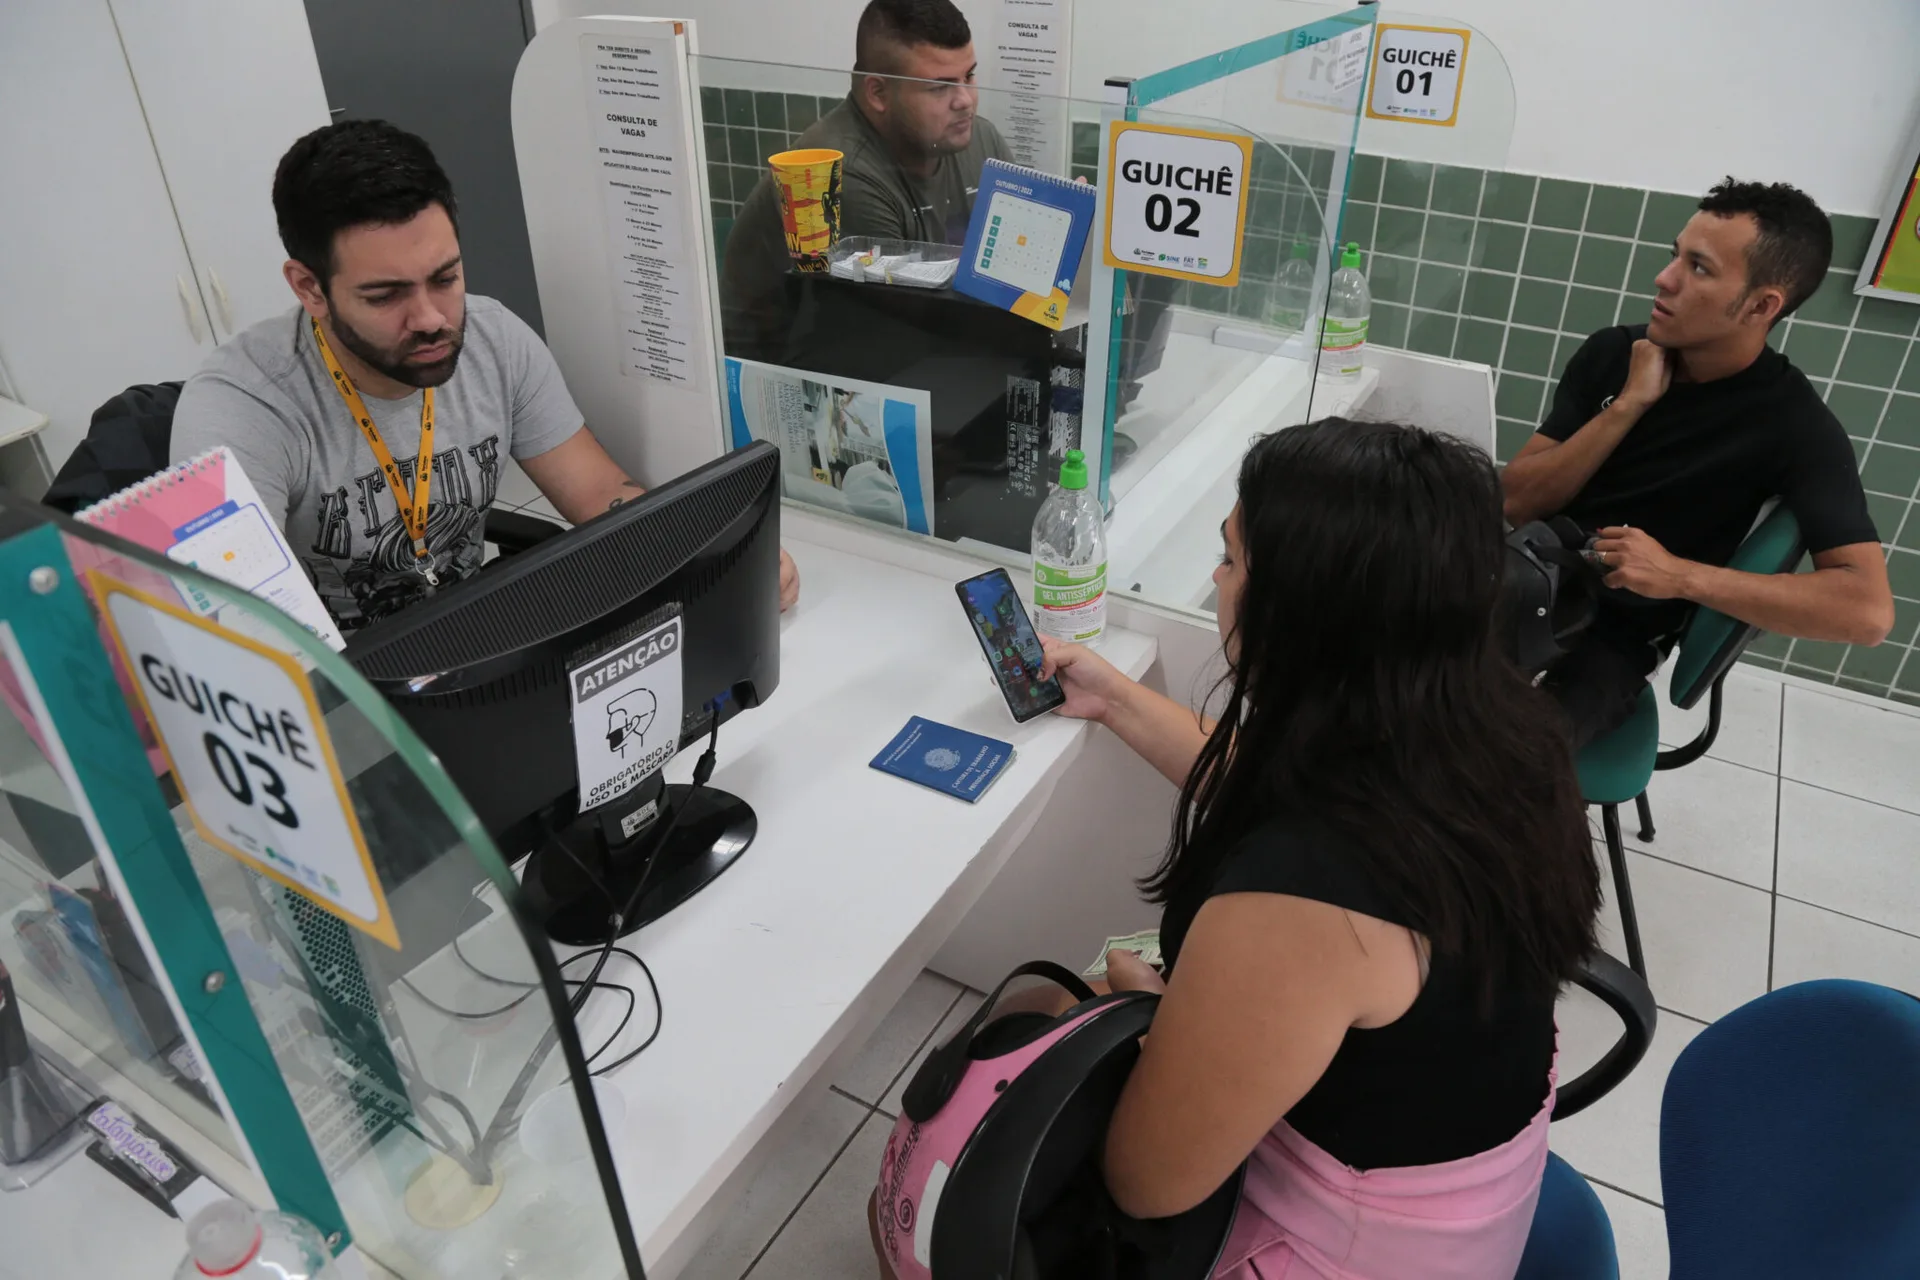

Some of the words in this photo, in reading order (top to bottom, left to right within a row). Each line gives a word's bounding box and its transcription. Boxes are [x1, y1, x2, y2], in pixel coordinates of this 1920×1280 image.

[1008, 22, 1039, 30] CONSULTA
[1382, 48, 1456, 69] GUICHÊ
[1396, 69, 1433, 96] 01
[606, 114, 646, 126] CONSULTA
[648, 119, 658, 127] DE
[621, 127, 646, 137] VAGAS
[1122, 159, 1233, 196] GUICHÊ
[1145, 193, 1201, 238] 02
[1042, 590, 1055, 600] GEL
[581, 632, 675, 696] ATENÇÃO
[140, 654, 316, 772] GUICHÊ
[666, 739, 673, 748] O
[204, 731, 299, 829] 03
[586, 790, 610, 808] USO
[614, 781, 628, 794] DE
